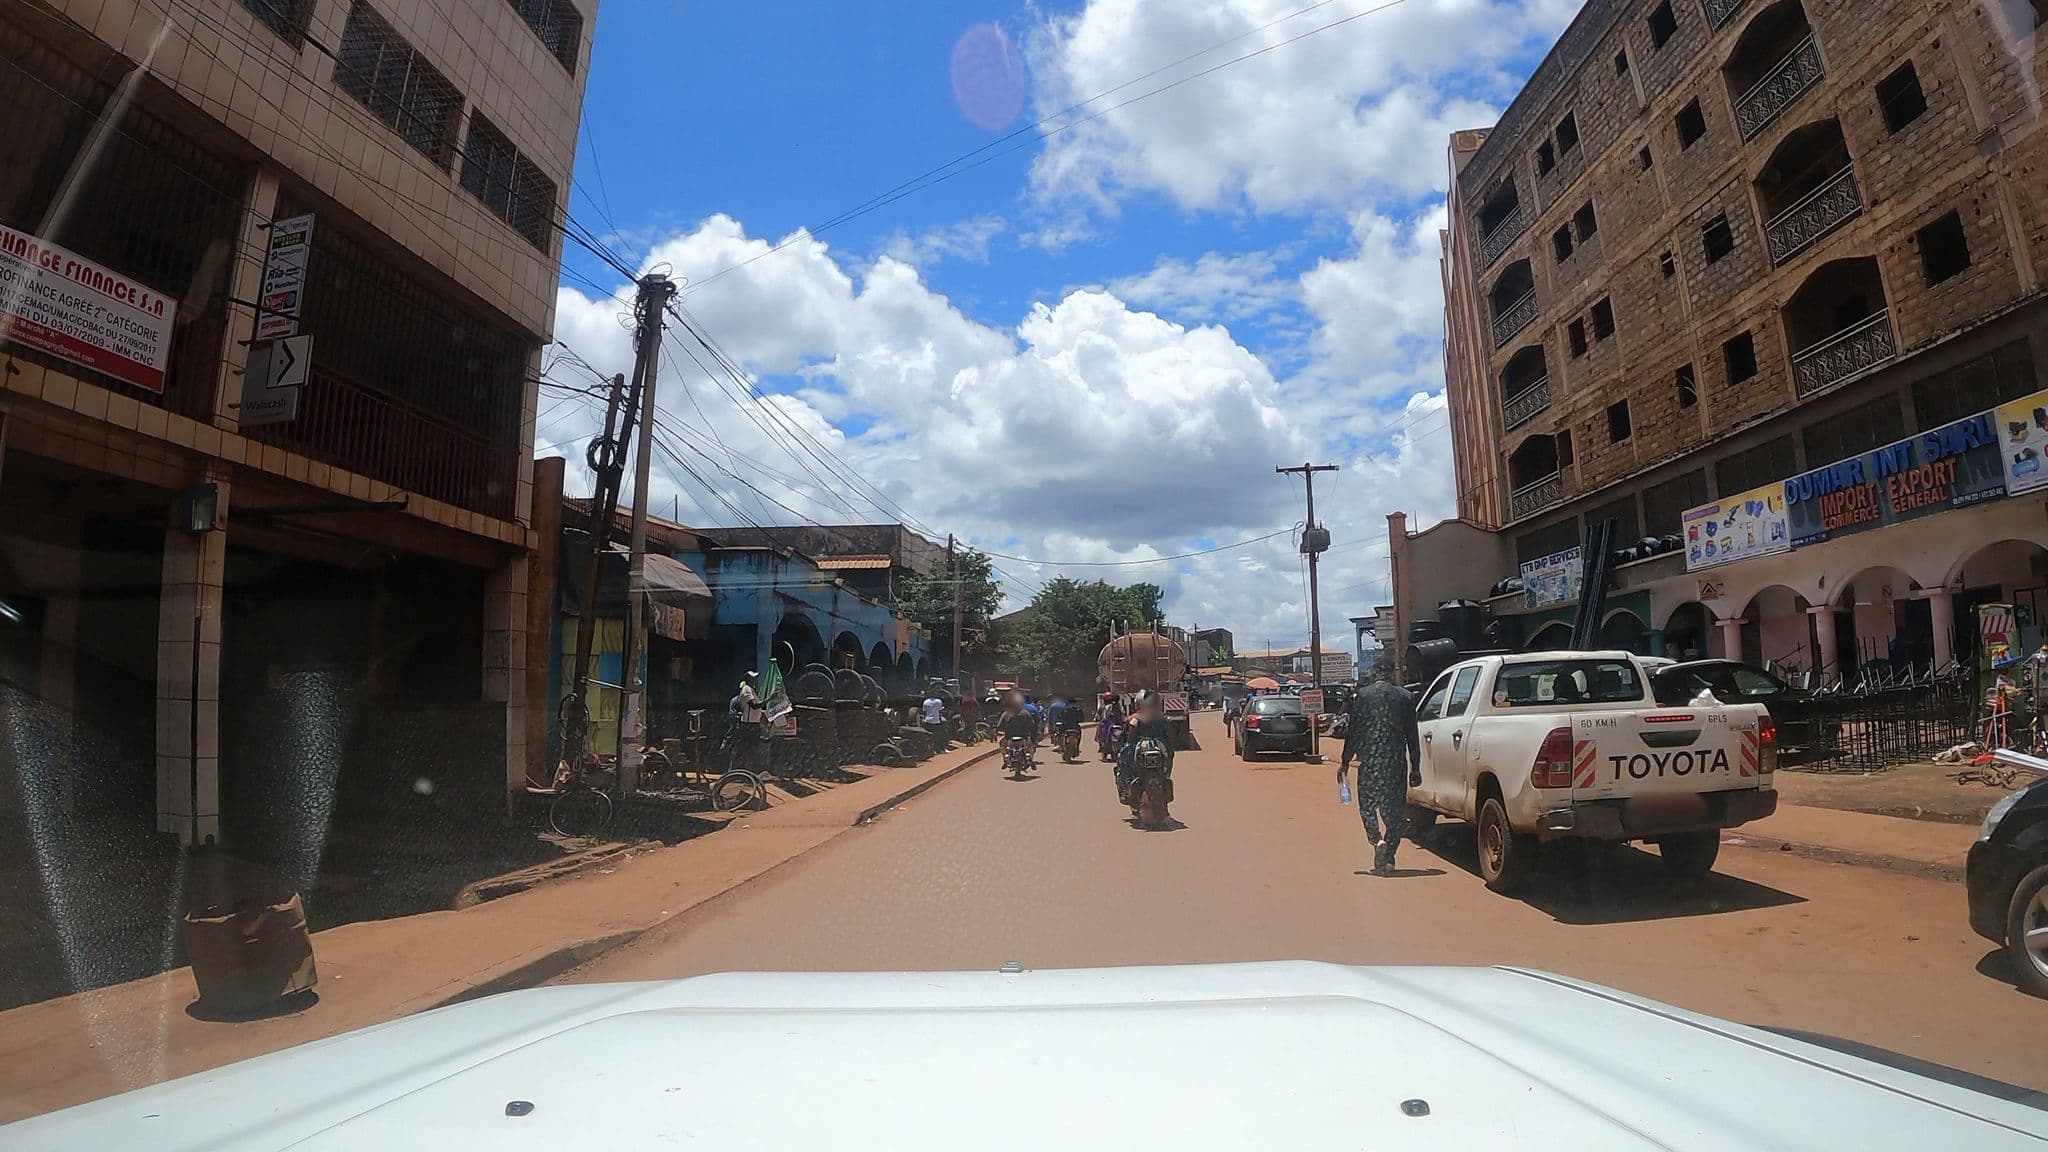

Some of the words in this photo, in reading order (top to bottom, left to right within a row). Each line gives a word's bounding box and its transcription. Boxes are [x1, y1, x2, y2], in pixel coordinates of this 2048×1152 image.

[0, 230, 62, 272] HANGE
[65, 260, 137, 304] FINANCE
[33, 311, 48, 324] DU
[51, 319, 104, 346] 03/07/2009
[112, 343, 131, 357] IMM
[133, 351, 153, 366] CNC
[106, 312, 158, 342] CATÉGORIE
[106, 328, 118, 340] DU
[1784, 457, 1865, 506] OUMAR
[1872, 440, 1913, 478] INT
[1924, 415, 1998, 461] SARL
[1819, 480, 1877, 519] IMPORT
[1888, 457, 1959, 500] EXPORT
[1823, 505, 1880, 531] COMMERCE
[1892, 487, 1948, 513] GENERAL
[1581, 719, 1592, 729] 60
[1609, 748, 1730, 780] TOYOTA
